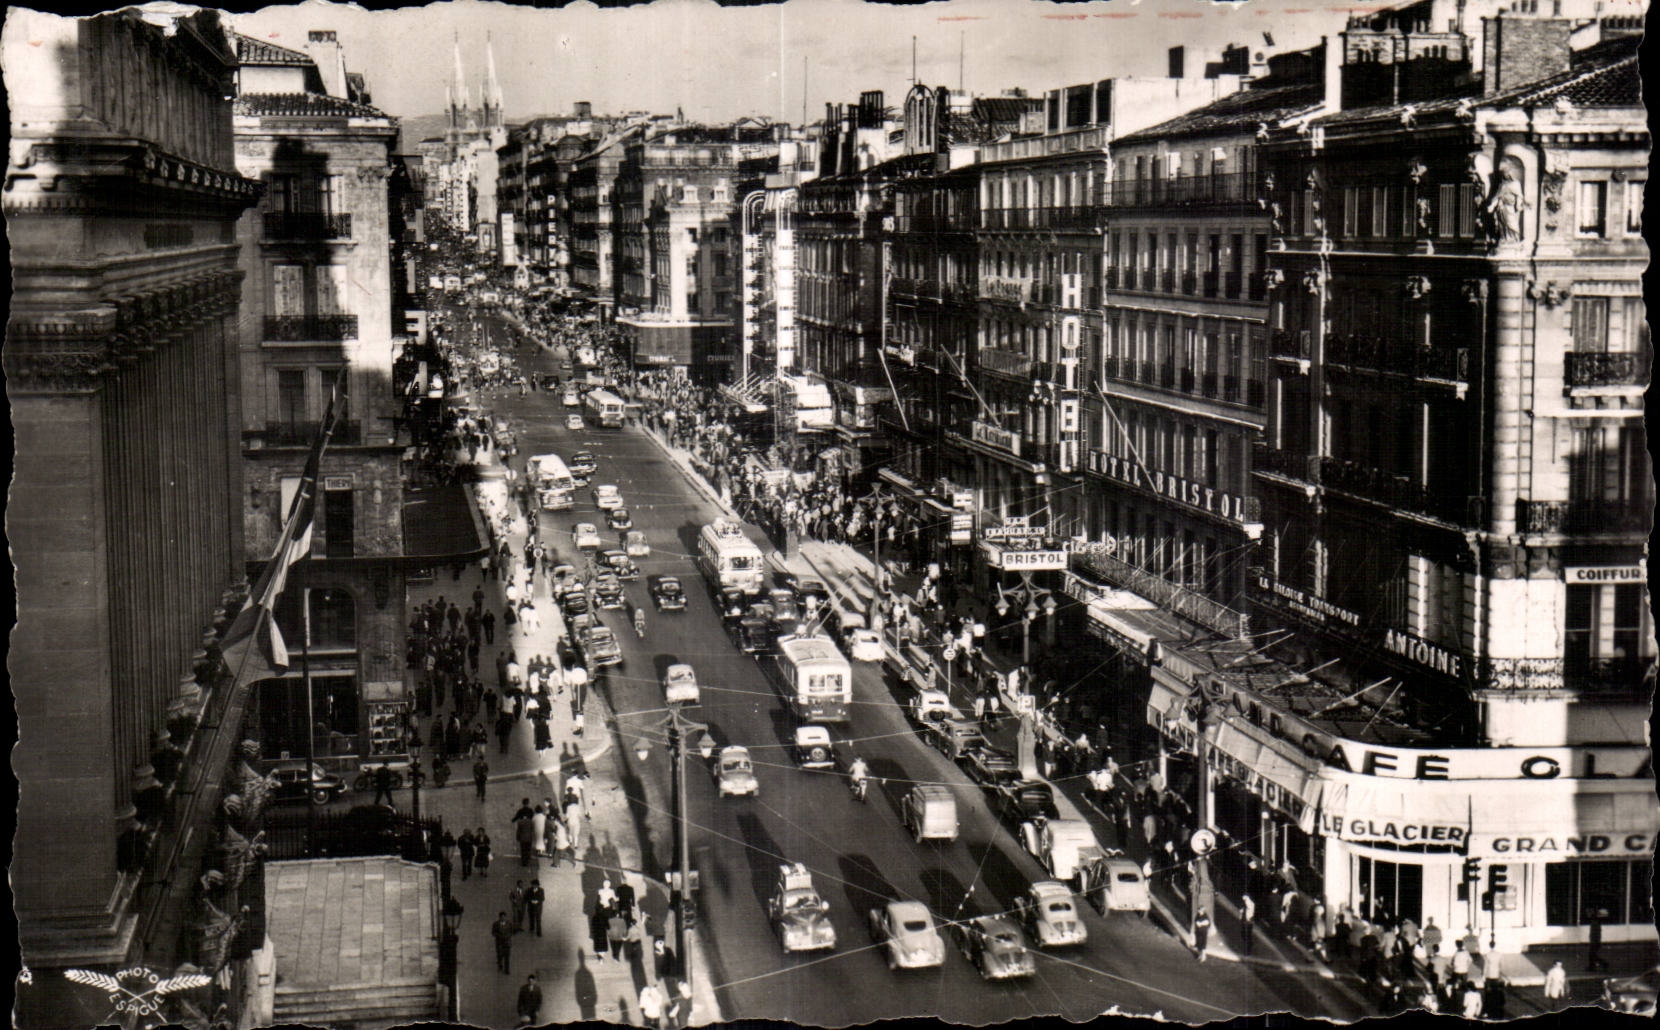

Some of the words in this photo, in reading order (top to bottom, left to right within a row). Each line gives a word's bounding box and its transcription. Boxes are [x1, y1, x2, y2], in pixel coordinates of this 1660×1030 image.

[1060, 274, 1081, 472] HOTEL
[1088, 450, 1141, 486] HOTEL
[1155, 471, 1245, 523] BRISTOL
[1005, 553, 1064, 565] BRISTOL
[1383, 629, 1462, 678] ANTOINE
[1322, 814, 1344, 836] LE
[1351, 820, 1464, 841] GLACIER
[1493, 835, 1616, 852] GRAND
